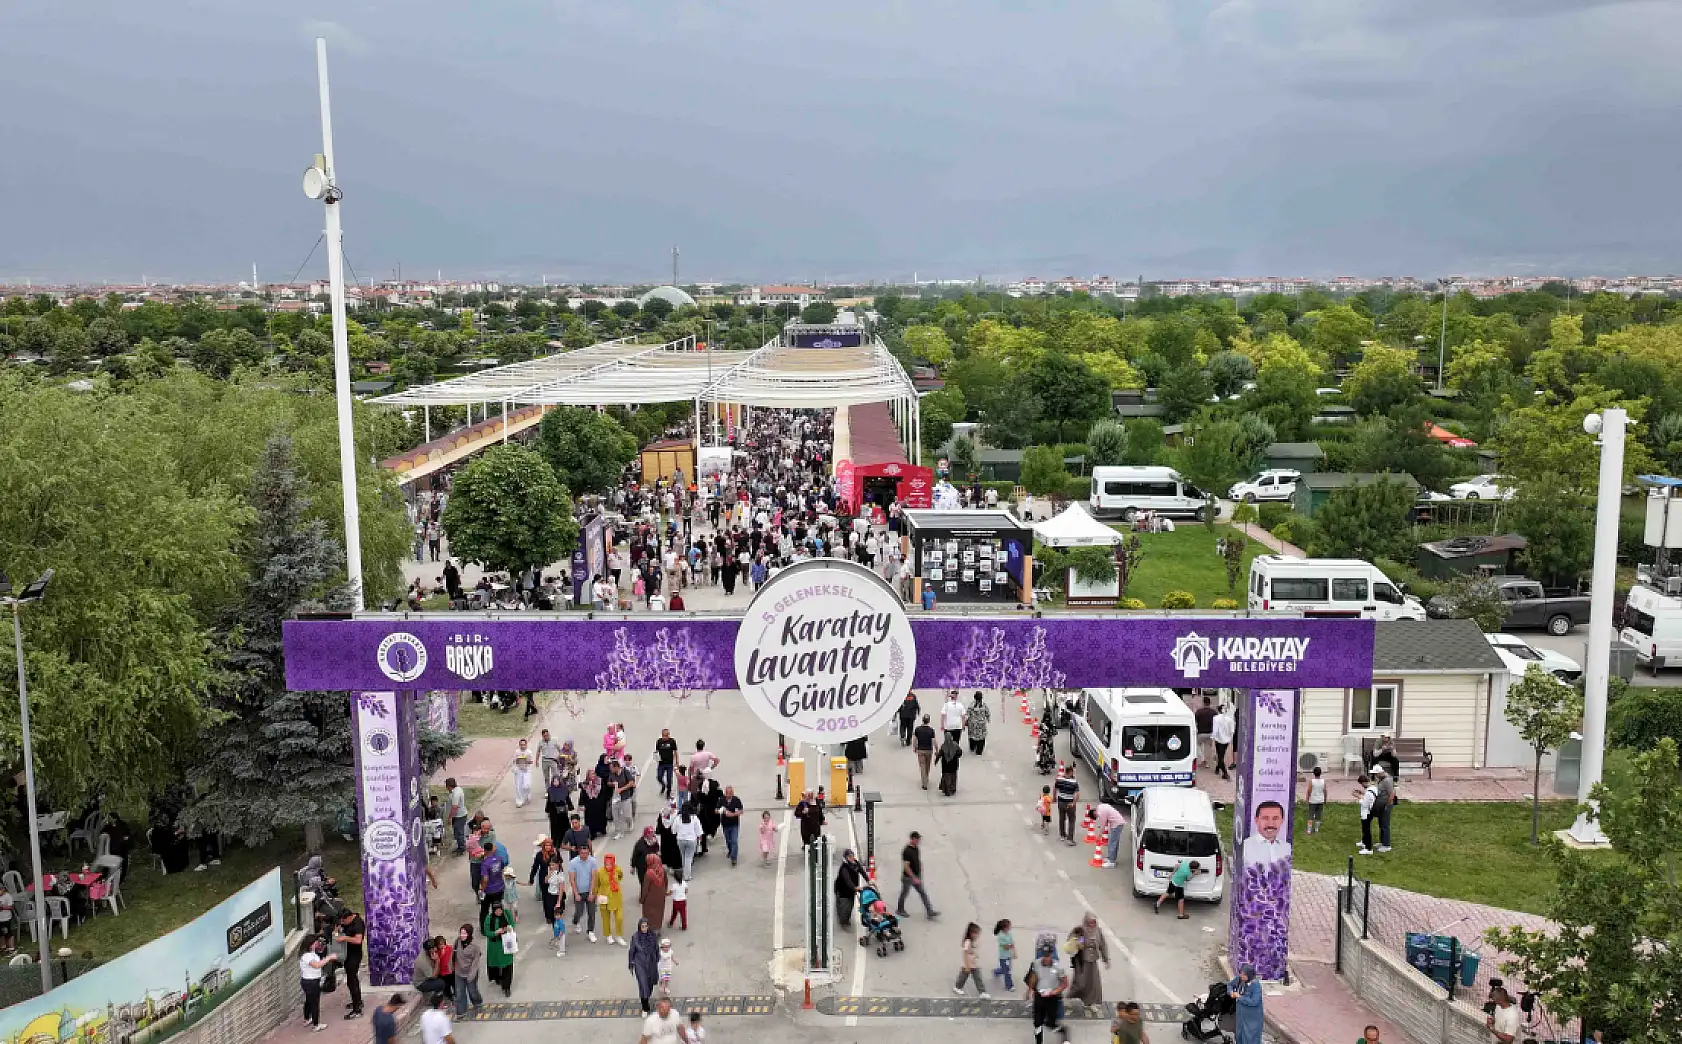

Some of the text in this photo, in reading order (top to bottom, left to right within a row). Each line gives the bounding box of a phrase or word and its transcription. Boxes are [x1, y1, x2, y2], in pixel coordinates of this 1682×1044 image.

[762, 585, 854, 625] 5. GELENEKSEL
[781, 609, 891, 645] Karatay
[746, 639, 872, 686] Lavanta
[1217, 637, 1311, 660] KARATAY
[1229, 660, 1297, 672] BELEDİYESİ
[779, 674, 885, 718] Günleri
[815, 715, 858, 732] 2026
